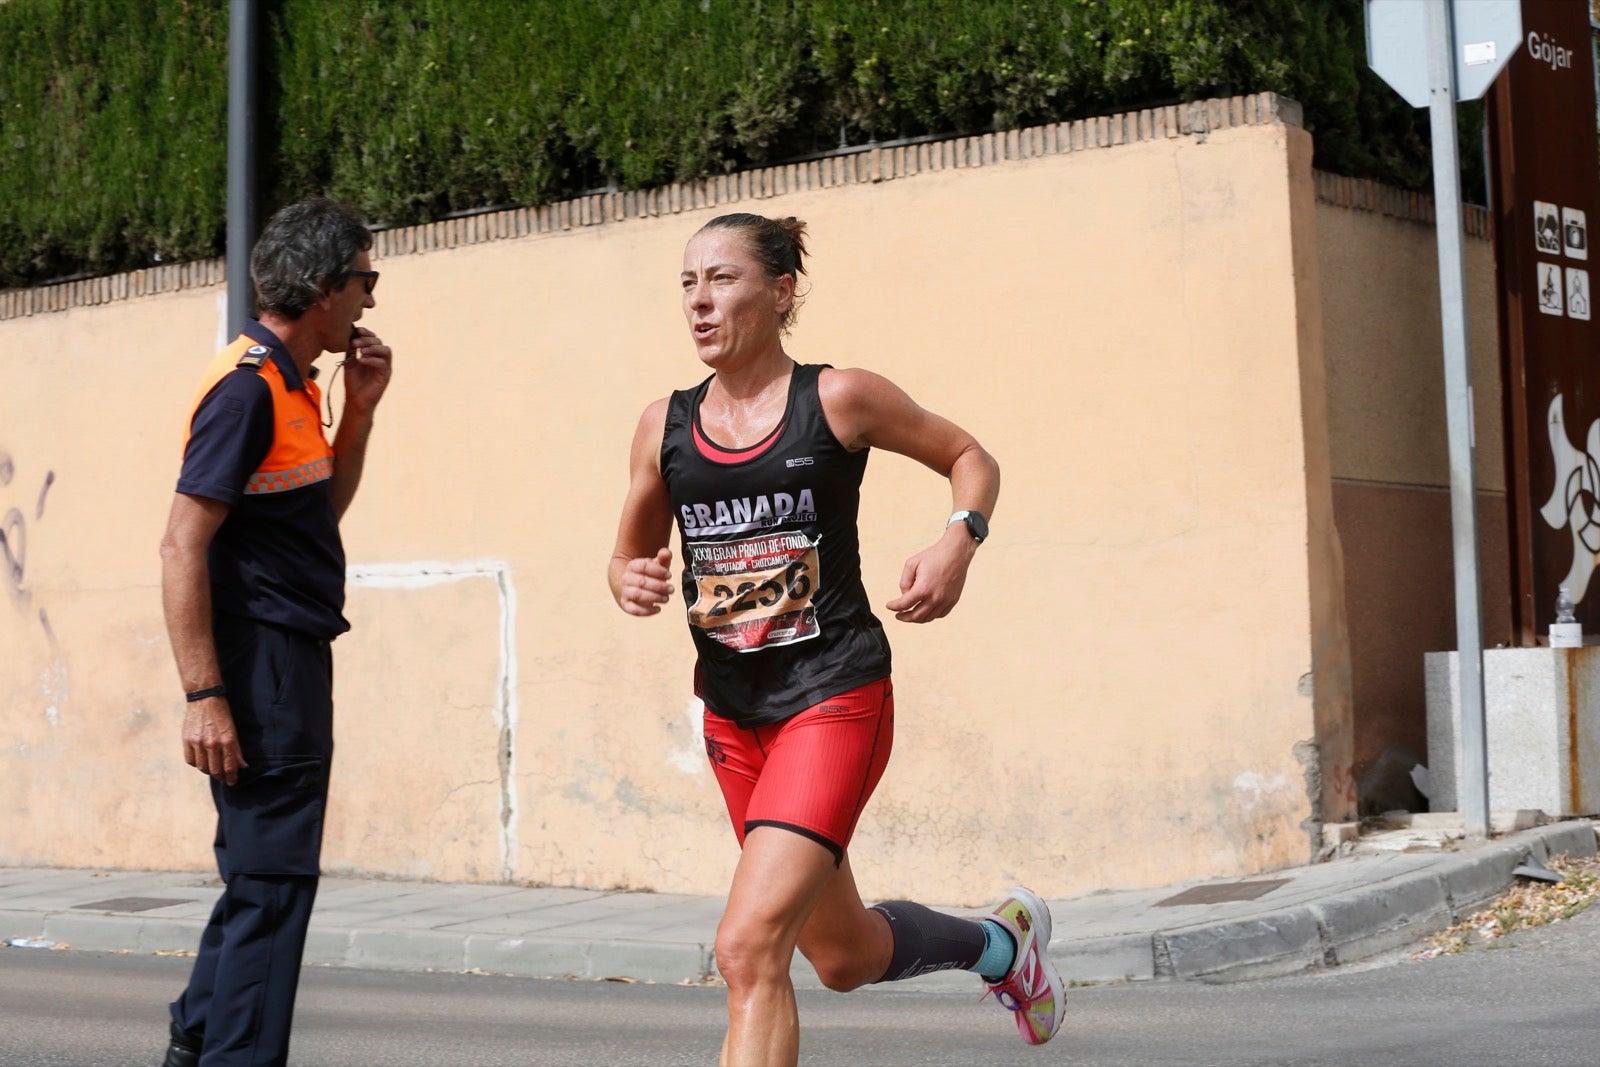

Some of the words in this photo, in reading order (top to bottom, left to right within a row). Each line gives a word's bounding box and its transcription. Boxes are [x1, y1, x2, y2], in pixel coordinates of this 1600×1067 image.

[1527, 31, 1573, 70] Gójar
[681, 488, 815, 529] GRANADA
[761, 517, 778, 528] RUN
[781, 513, 817, 524] PROJECT
[713, 545, 738, 561] GRAN
[739, 541, 768, 558] PREMIO
[770, 538, 778, 554] DE
[781, 535, 811, 551] FONDO
[751, 554, 790, 570] CRUZCAMPO
